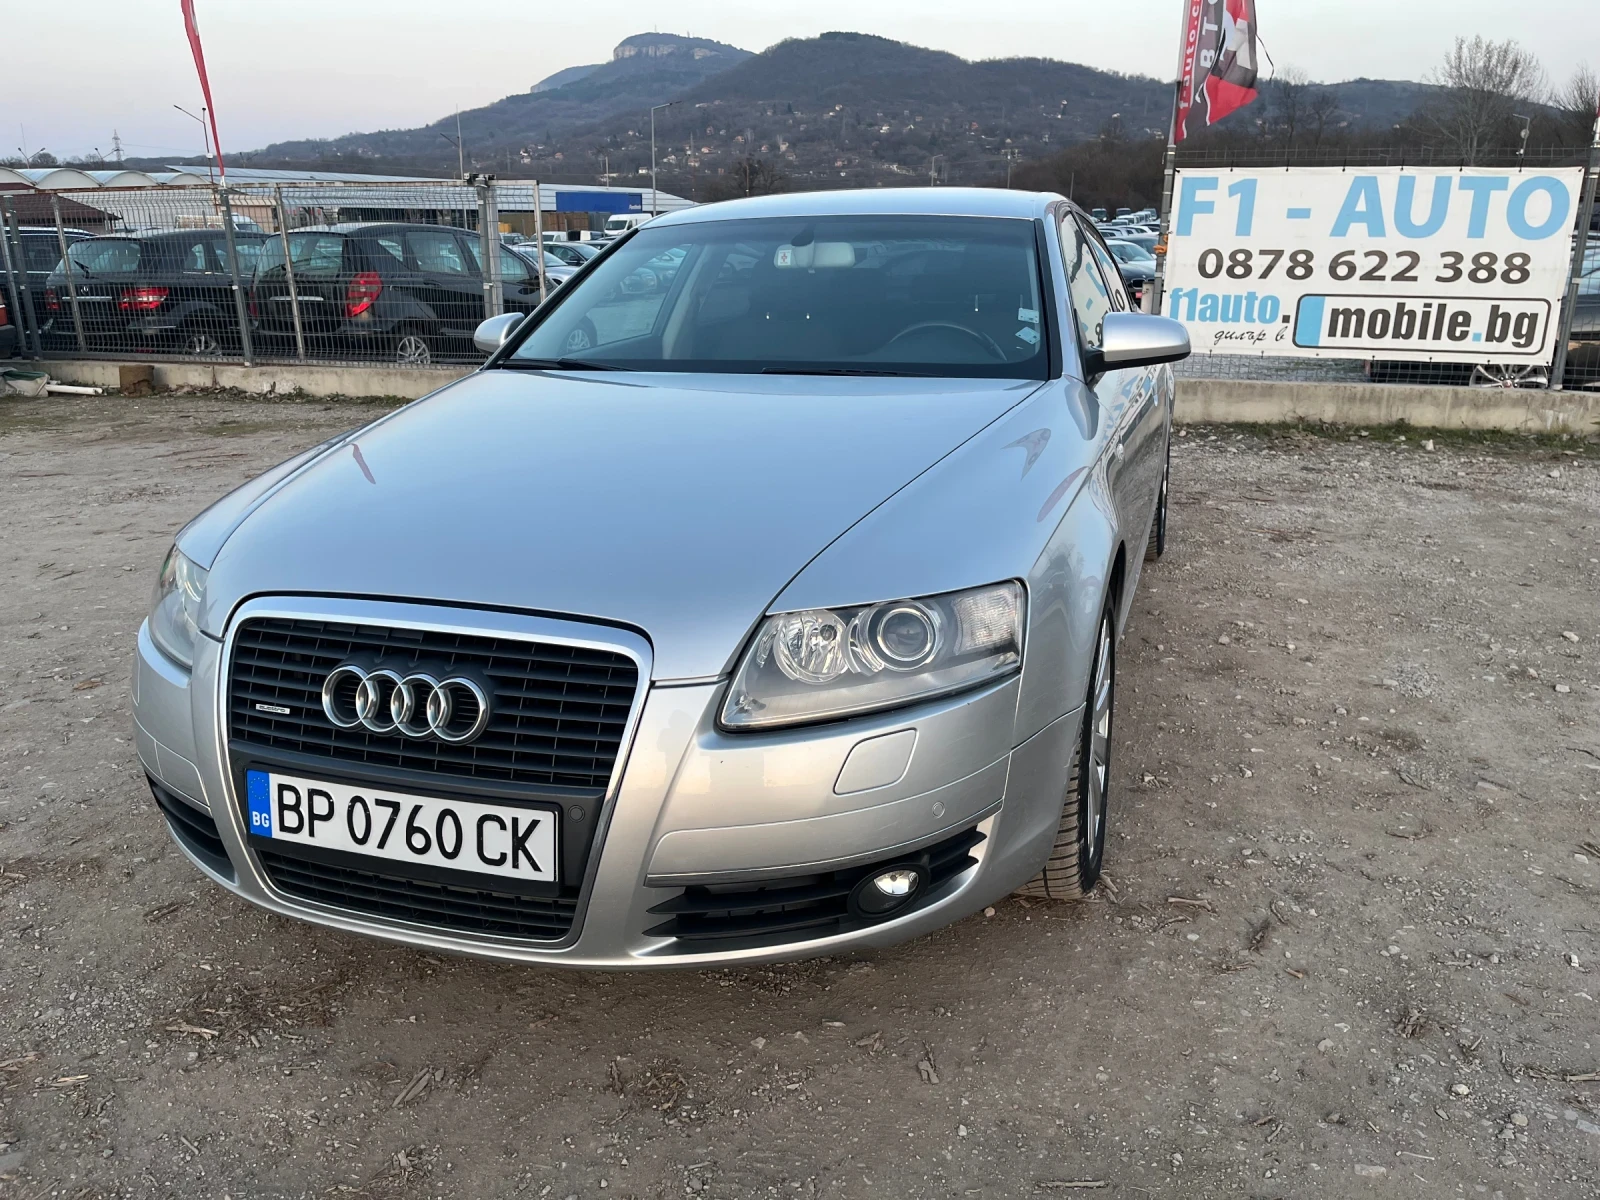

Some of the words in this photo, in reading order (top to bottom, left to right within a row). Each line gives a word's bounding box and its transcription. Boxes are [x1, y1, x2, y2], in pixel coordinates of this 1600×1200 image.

[1179, 0, 1200, 109] f-auto.c
[1175, 177, 1258, 237] F1
[1286, 207, 1312, 219] -
[1329, 175, 1571, 241] AUTO
[1197, 248, 1315, 281] 0878
[1328, 249, 1421, 283] 622
[1434, 251, 1532, 285] 388
[1327, 302, 1539, 349] mobile.bg
[252, 811, 270, 828] BG
[277, 783, 335, 838] BP
[346, 795, 463, 860] 0760
[476, 813, 543, 873] CK
